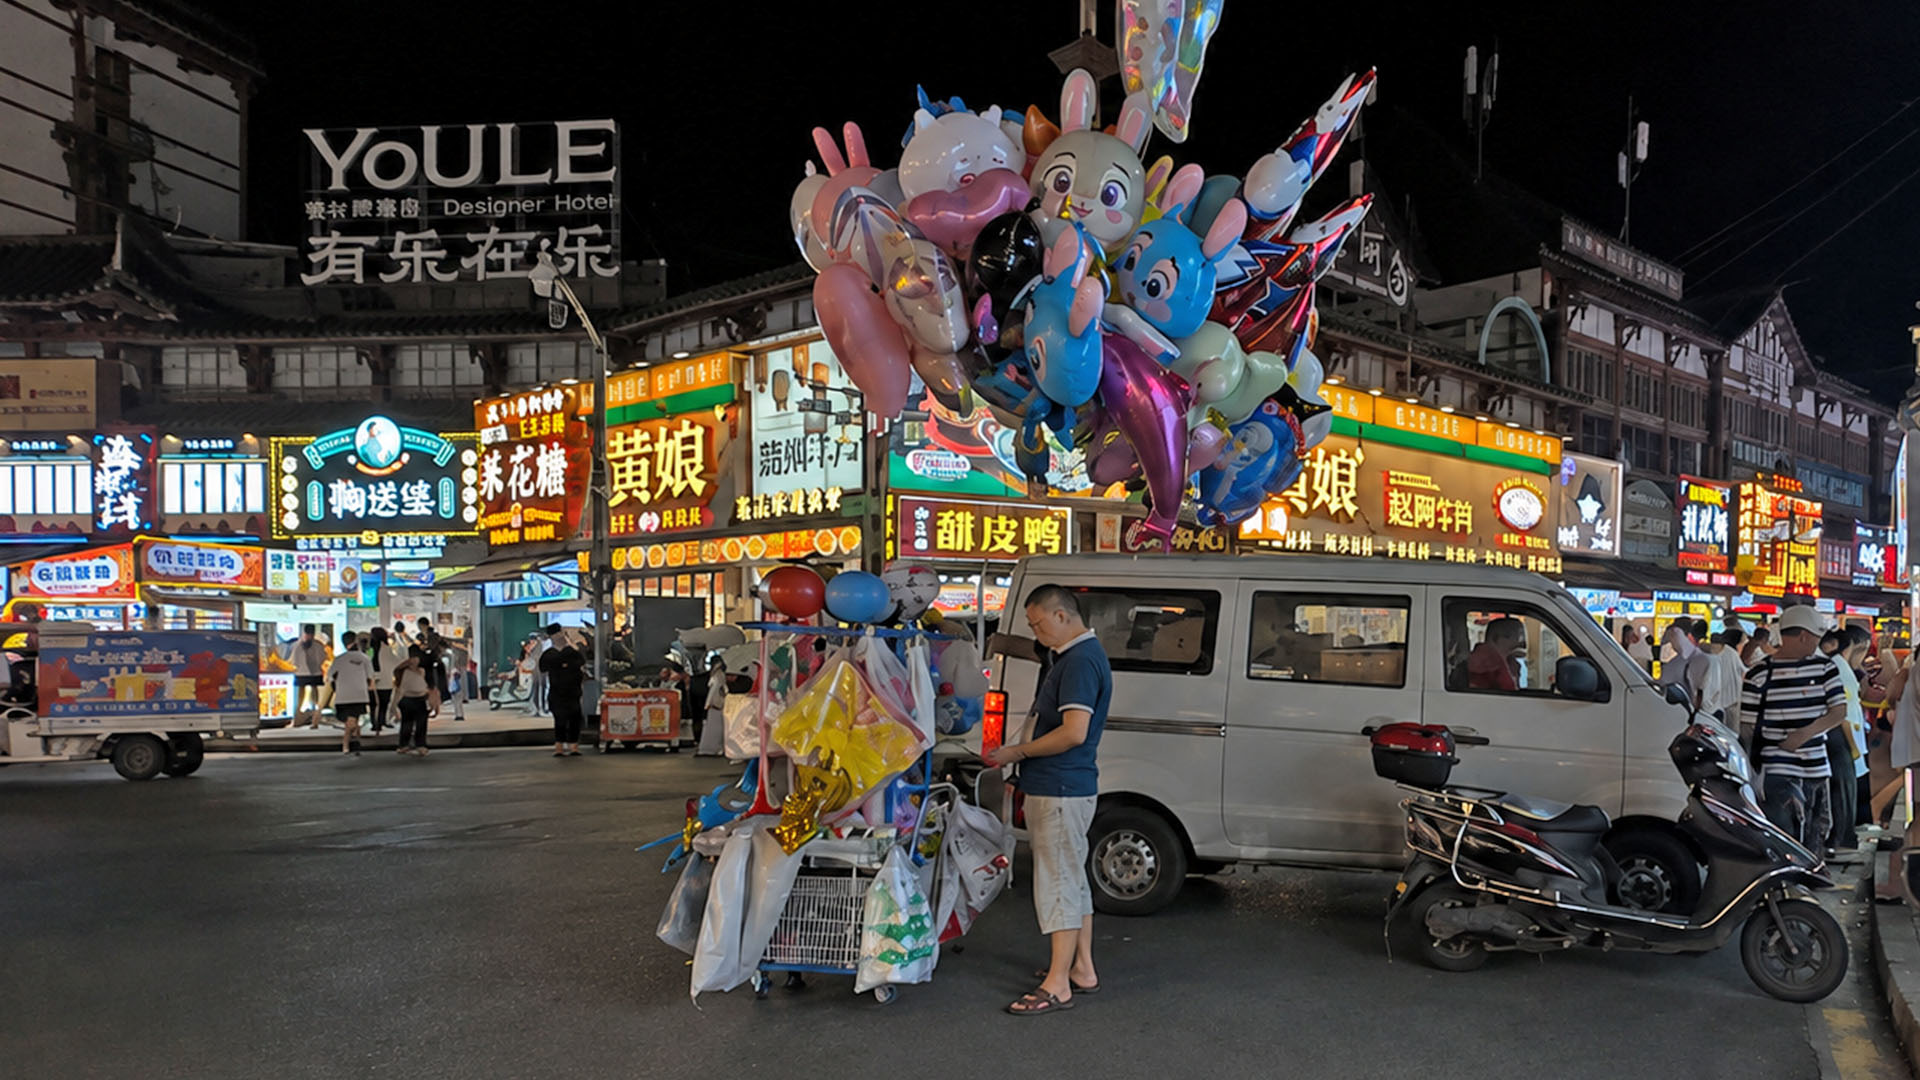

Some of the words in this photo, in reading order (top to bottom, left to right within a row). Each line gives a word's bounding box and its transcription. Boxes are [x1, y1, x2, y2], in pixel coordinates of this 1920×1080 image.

[443, 196, 546, 218] Designer
[554, 193, 614, 212] Hotel
[300, 224, 620, 286] 有乐在乐
